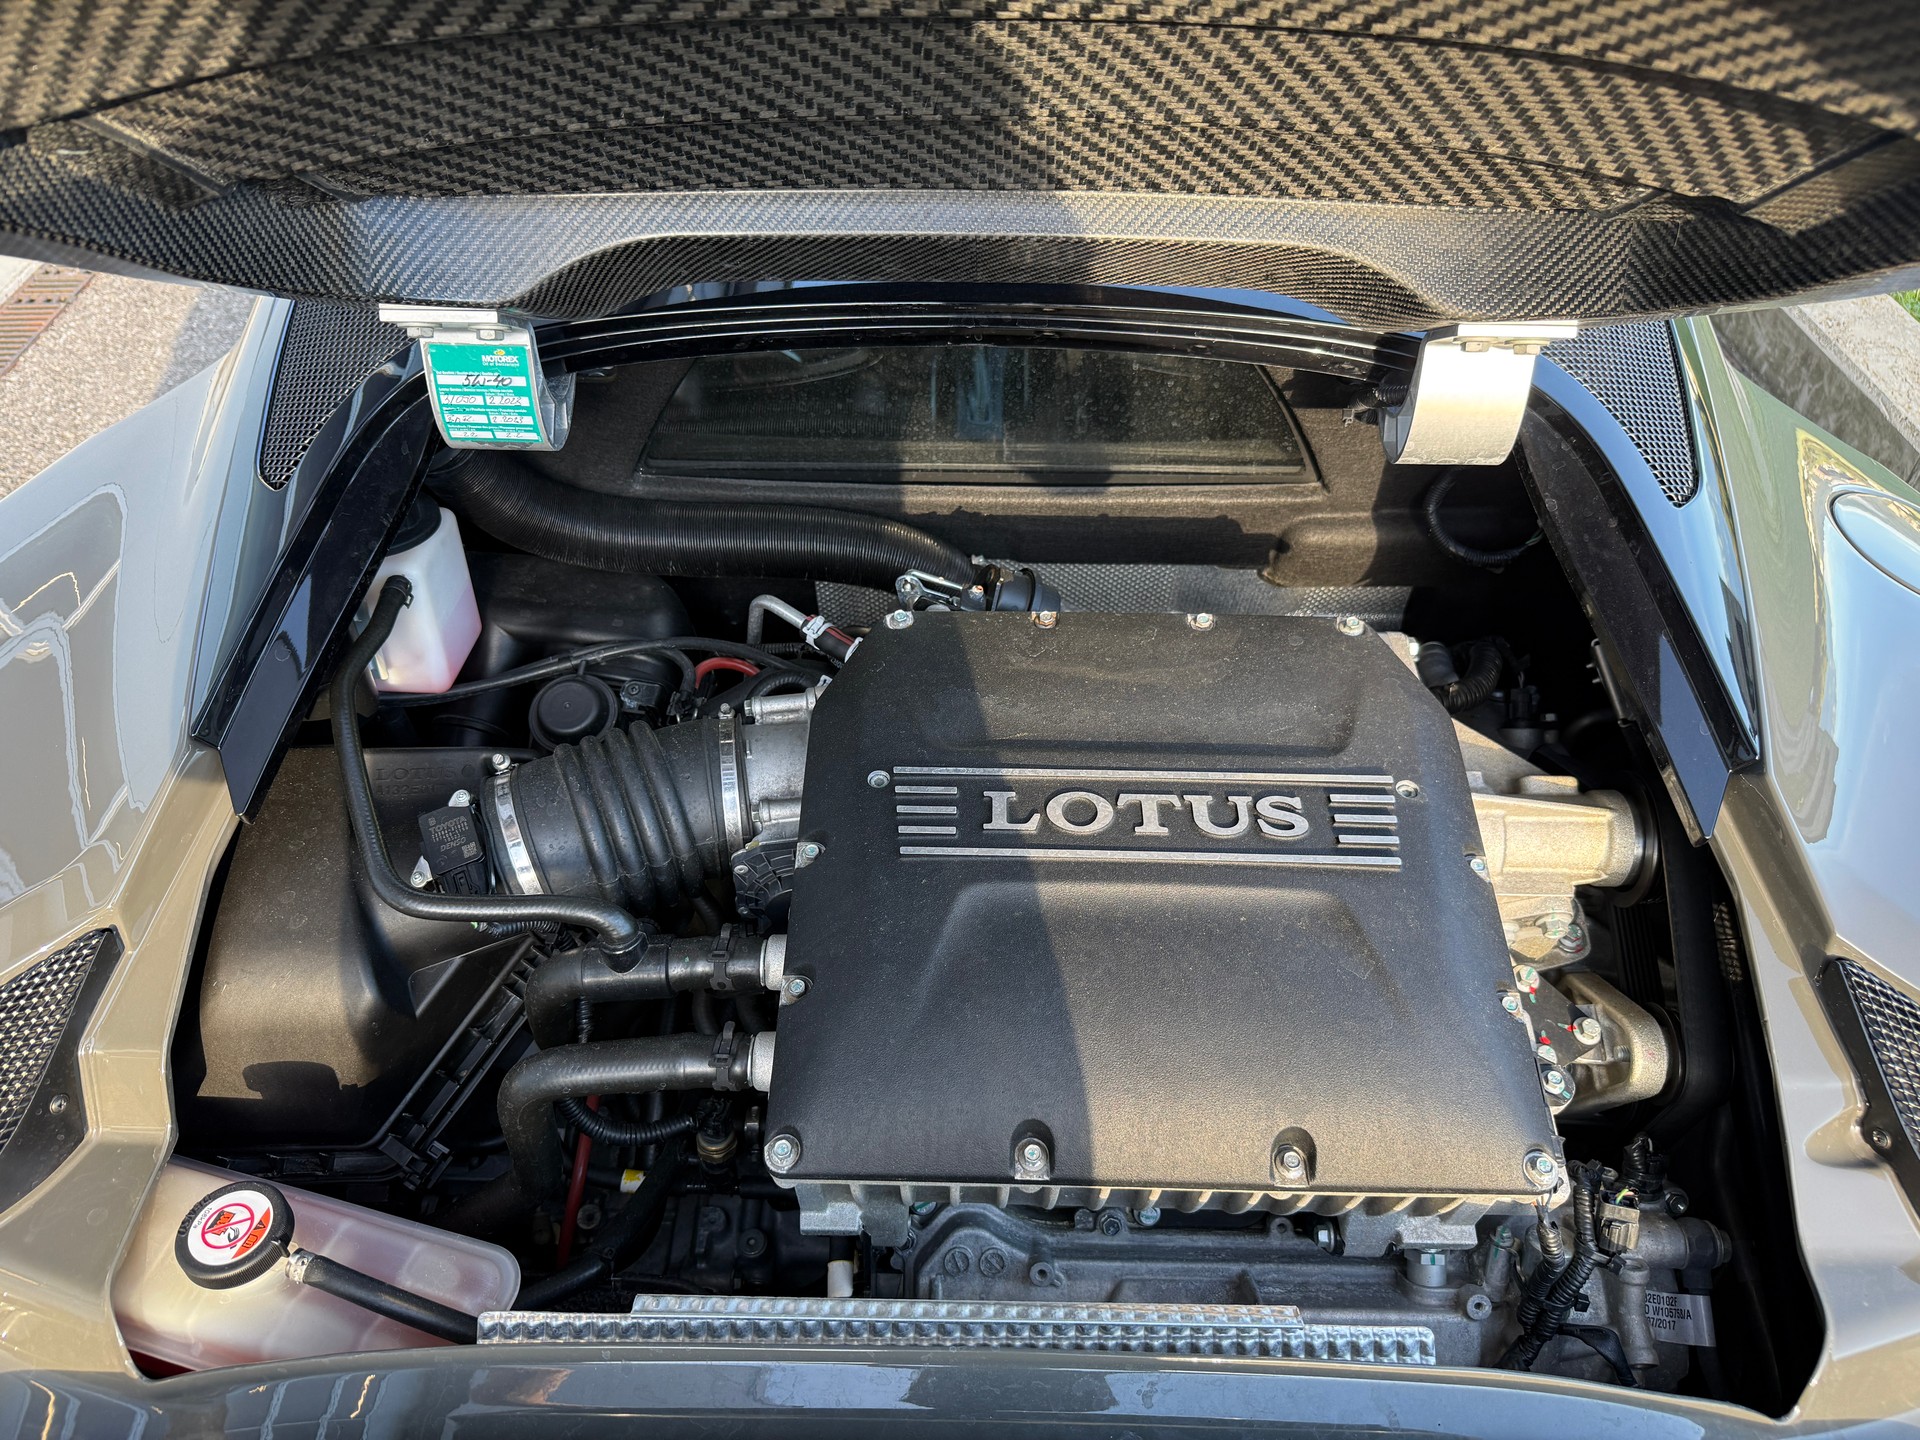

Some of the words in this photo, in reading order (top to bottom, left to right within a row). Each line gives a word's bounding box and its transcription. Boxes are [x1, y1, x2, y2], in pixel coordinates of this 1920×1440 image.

[482, 355, 519, 363] MOTOREX
[983, 790, 1310, 838] LOTUS
[429, 816, 467, 834] TOYOTA
[440, 836, 467, 852] DENSO
[177, 1194, 212, 1238] DENSO
